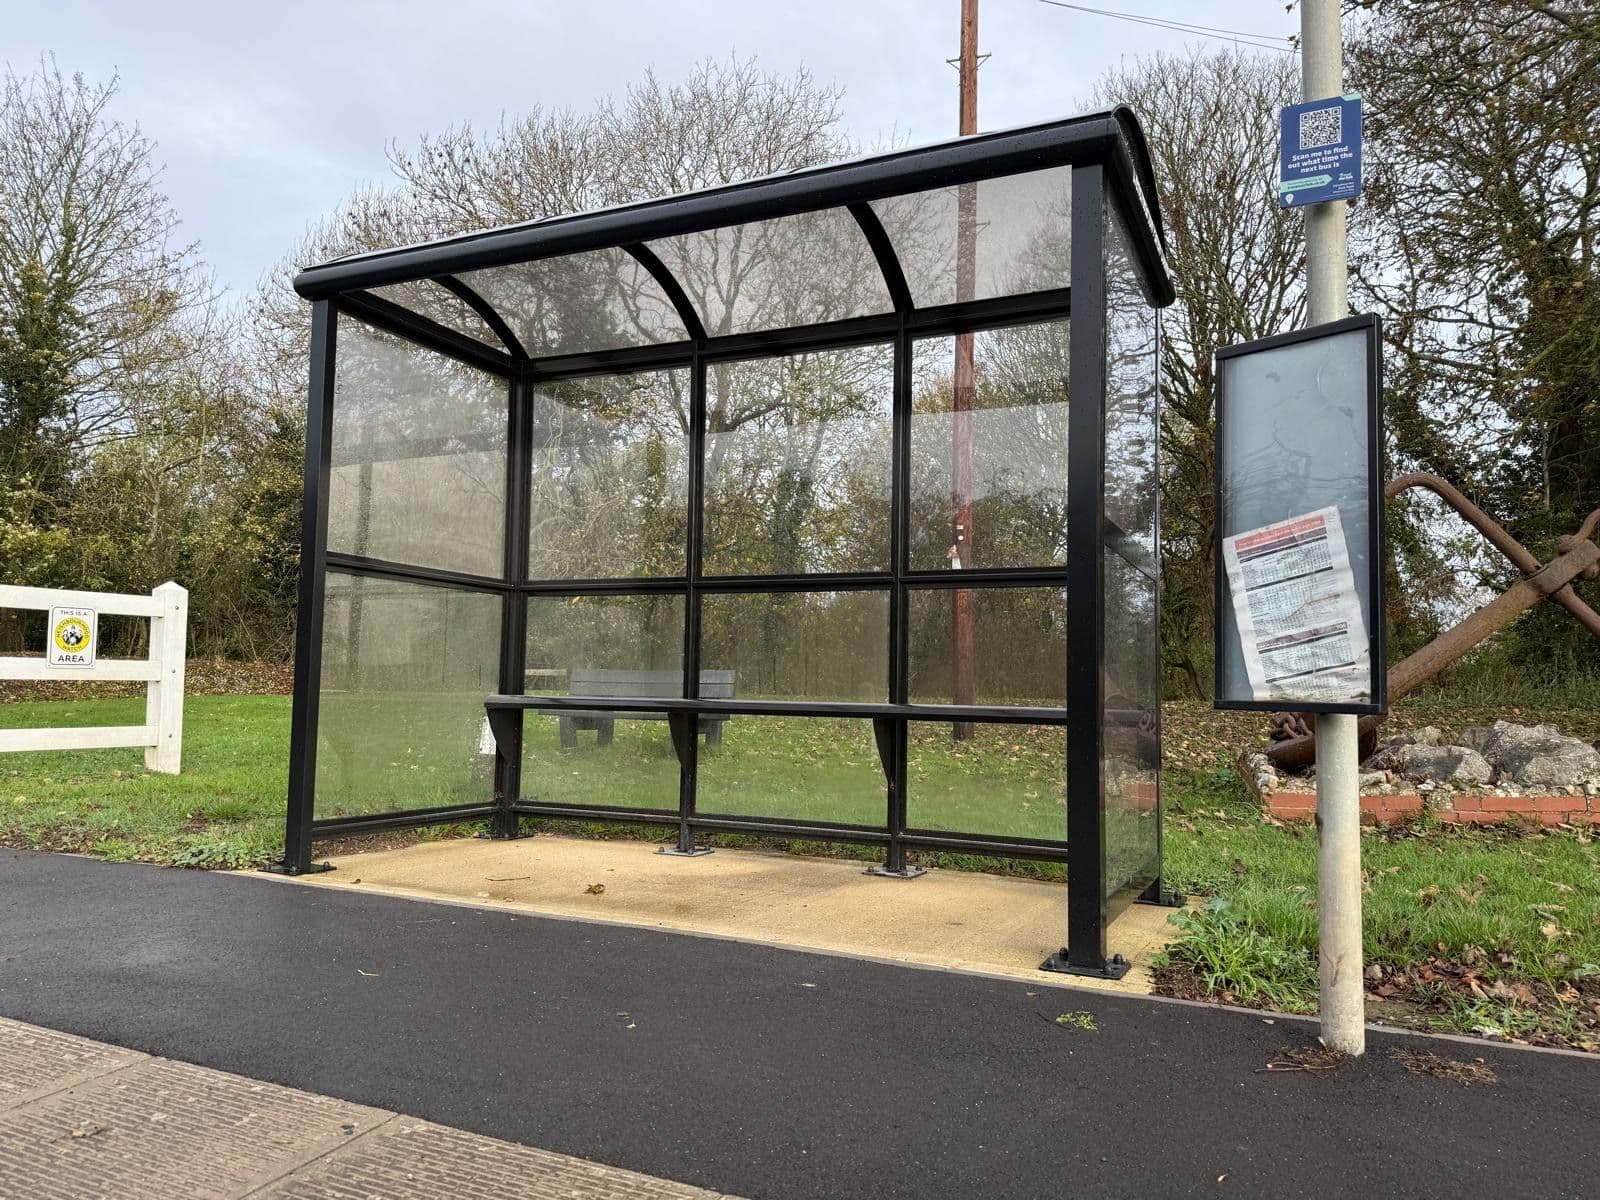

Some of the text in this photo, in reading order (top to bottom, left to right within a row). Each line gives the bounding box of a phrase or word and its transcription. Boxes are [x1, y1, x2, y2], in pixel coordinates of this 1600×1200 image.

[1292, 154, 1310, 162] Scan
[1333, 146, 1349, 154] find
[1301, 158, 1321, 167] what
[1322, 155, 1339, 163] time
[1340, 152, 1353, 160] the
[1300, 166, 1318, 174] next
